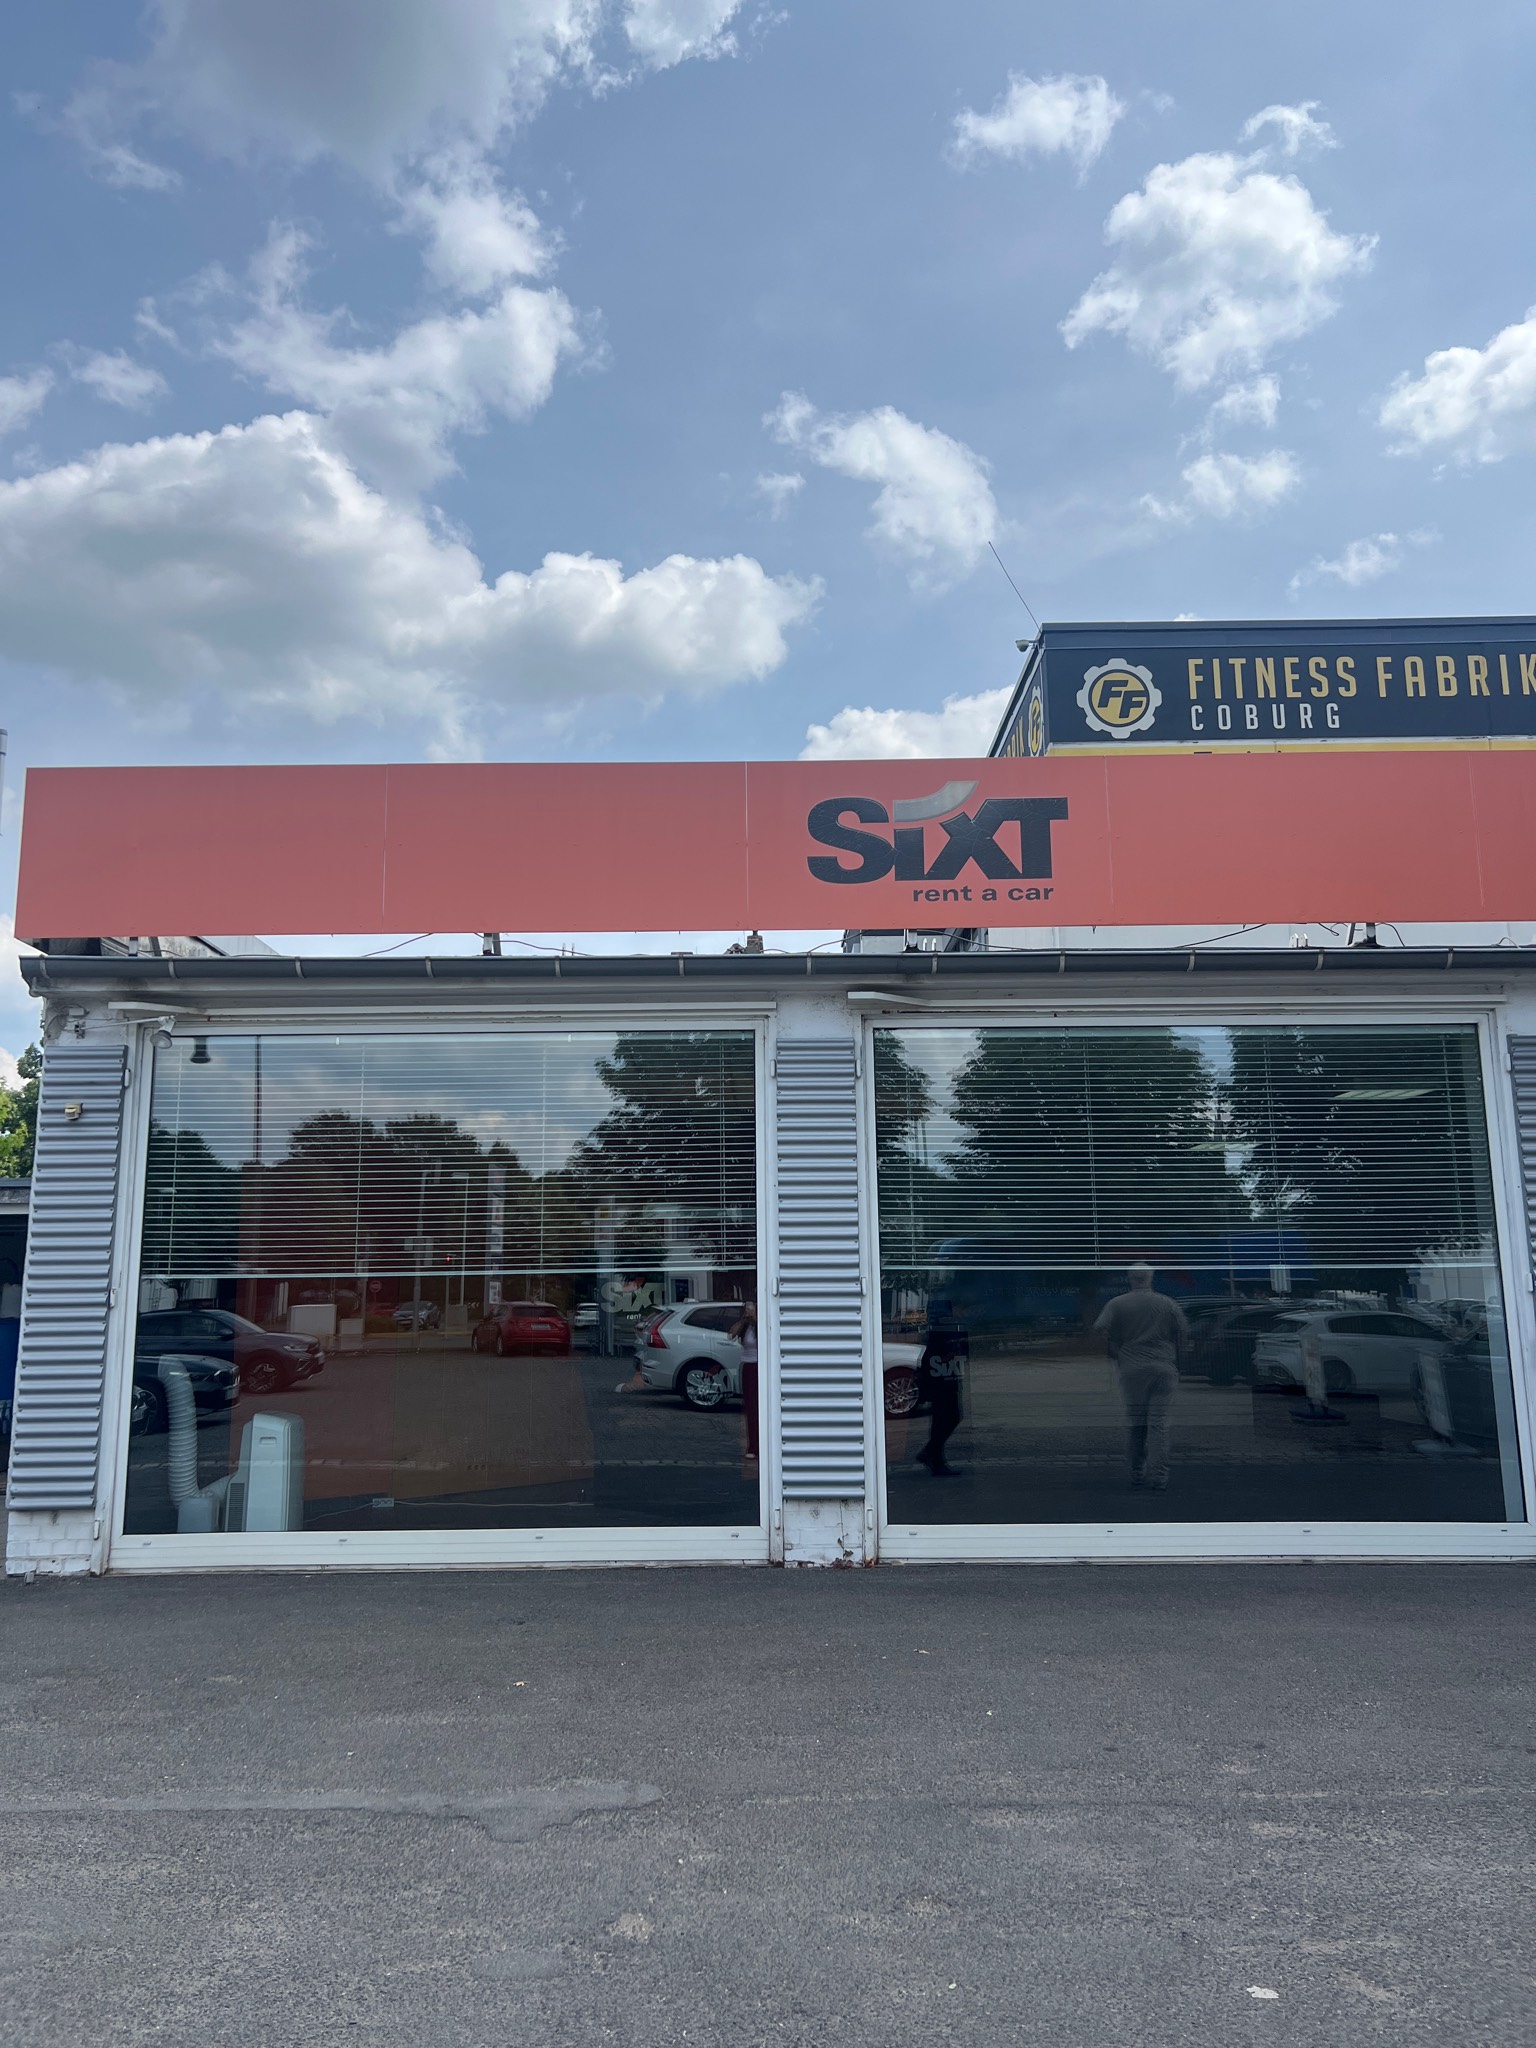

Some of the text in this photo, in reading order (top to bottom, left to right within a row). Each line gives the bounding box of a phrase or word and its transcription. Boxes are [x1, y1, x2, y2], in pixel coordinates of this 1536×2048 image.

[1187, 652, 1536, 699] FITNESS FABRIK
[1097, 679, 1148, 719] FF
[1190, 702, 1341, 731] COBURG
[806, 780, 1069, 884] SIXT
[913, 885, 1055, 902] rent a car
